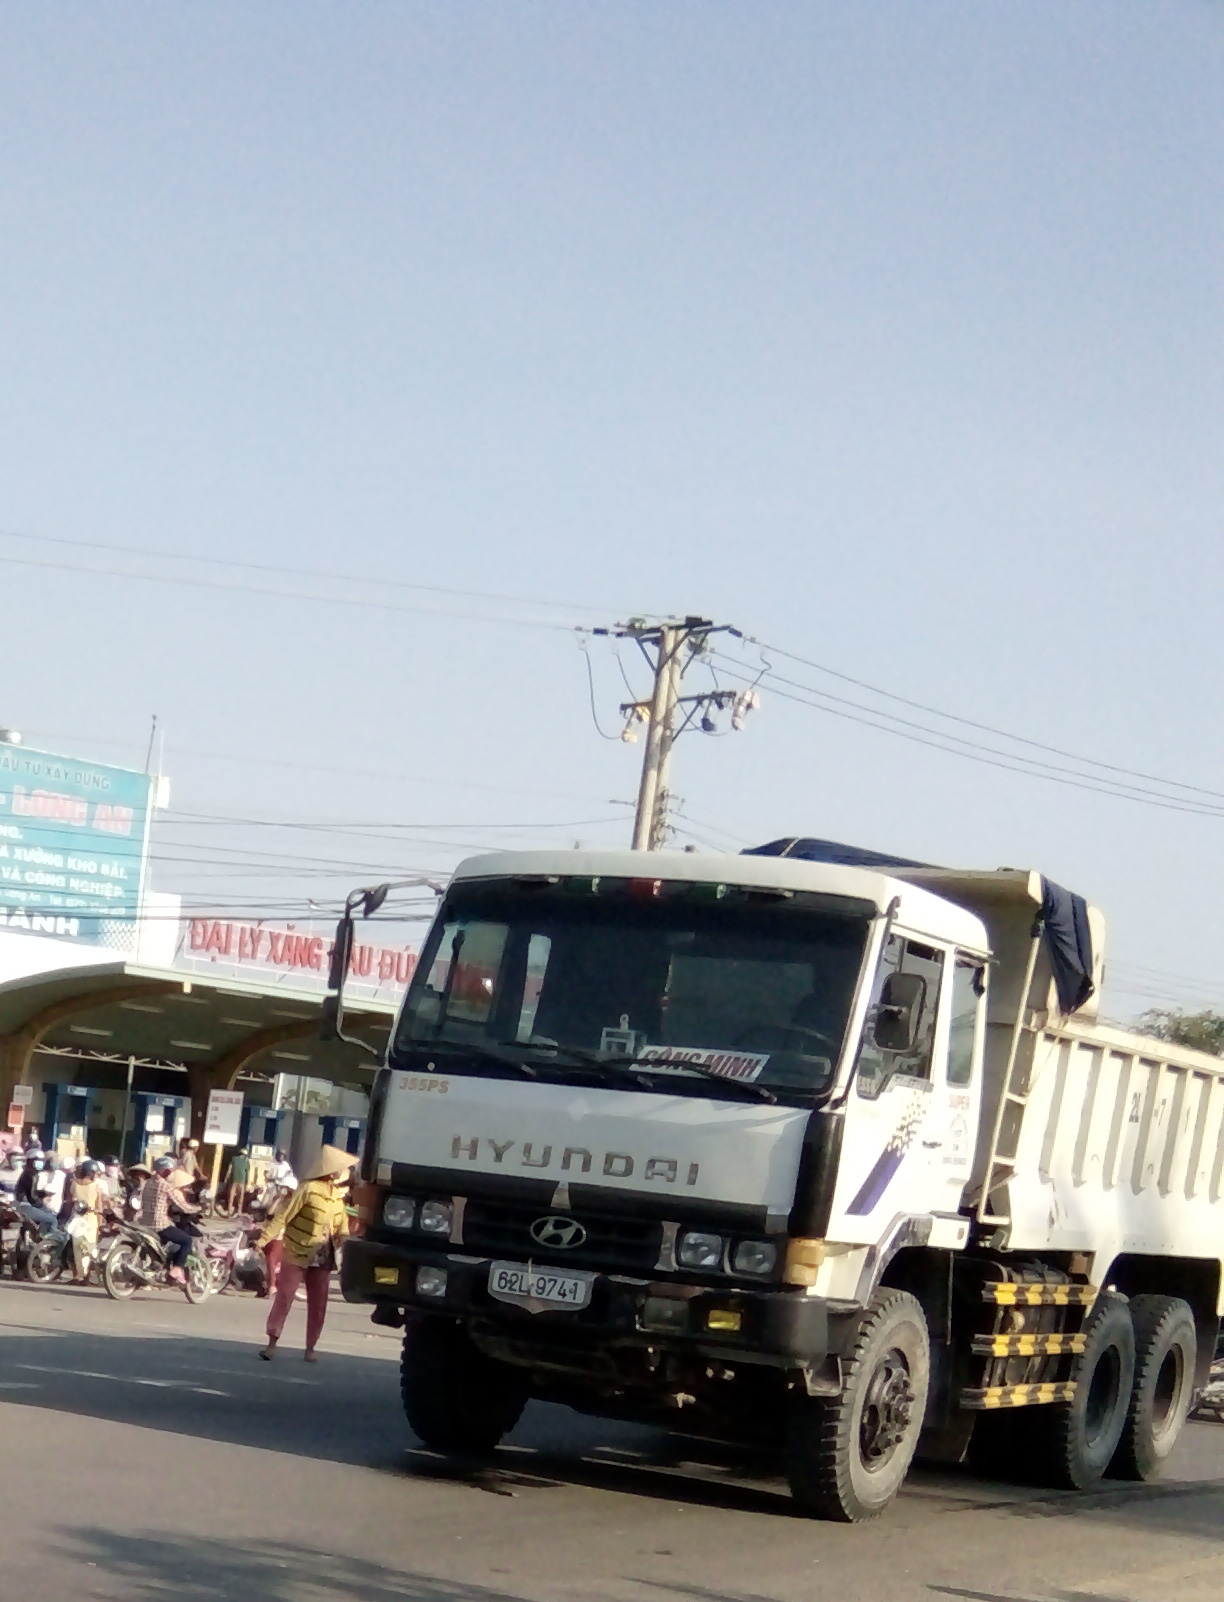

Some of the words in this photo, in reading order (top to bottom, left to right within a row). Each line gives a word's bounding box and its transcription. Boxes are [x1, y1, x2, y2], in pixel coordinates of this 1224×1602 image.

[92, 804, 134, 836] AN
[68, 857, 98, 873] KHO
[190, 918, 232, 962] ĐẠI
[238, 919, 264, 961] LÝ
[266, 923, 323, 972] XĂNG
[703, 1053, 762, 1078] MINH
[451, 1134, 699, 1186] HYUNDAI
